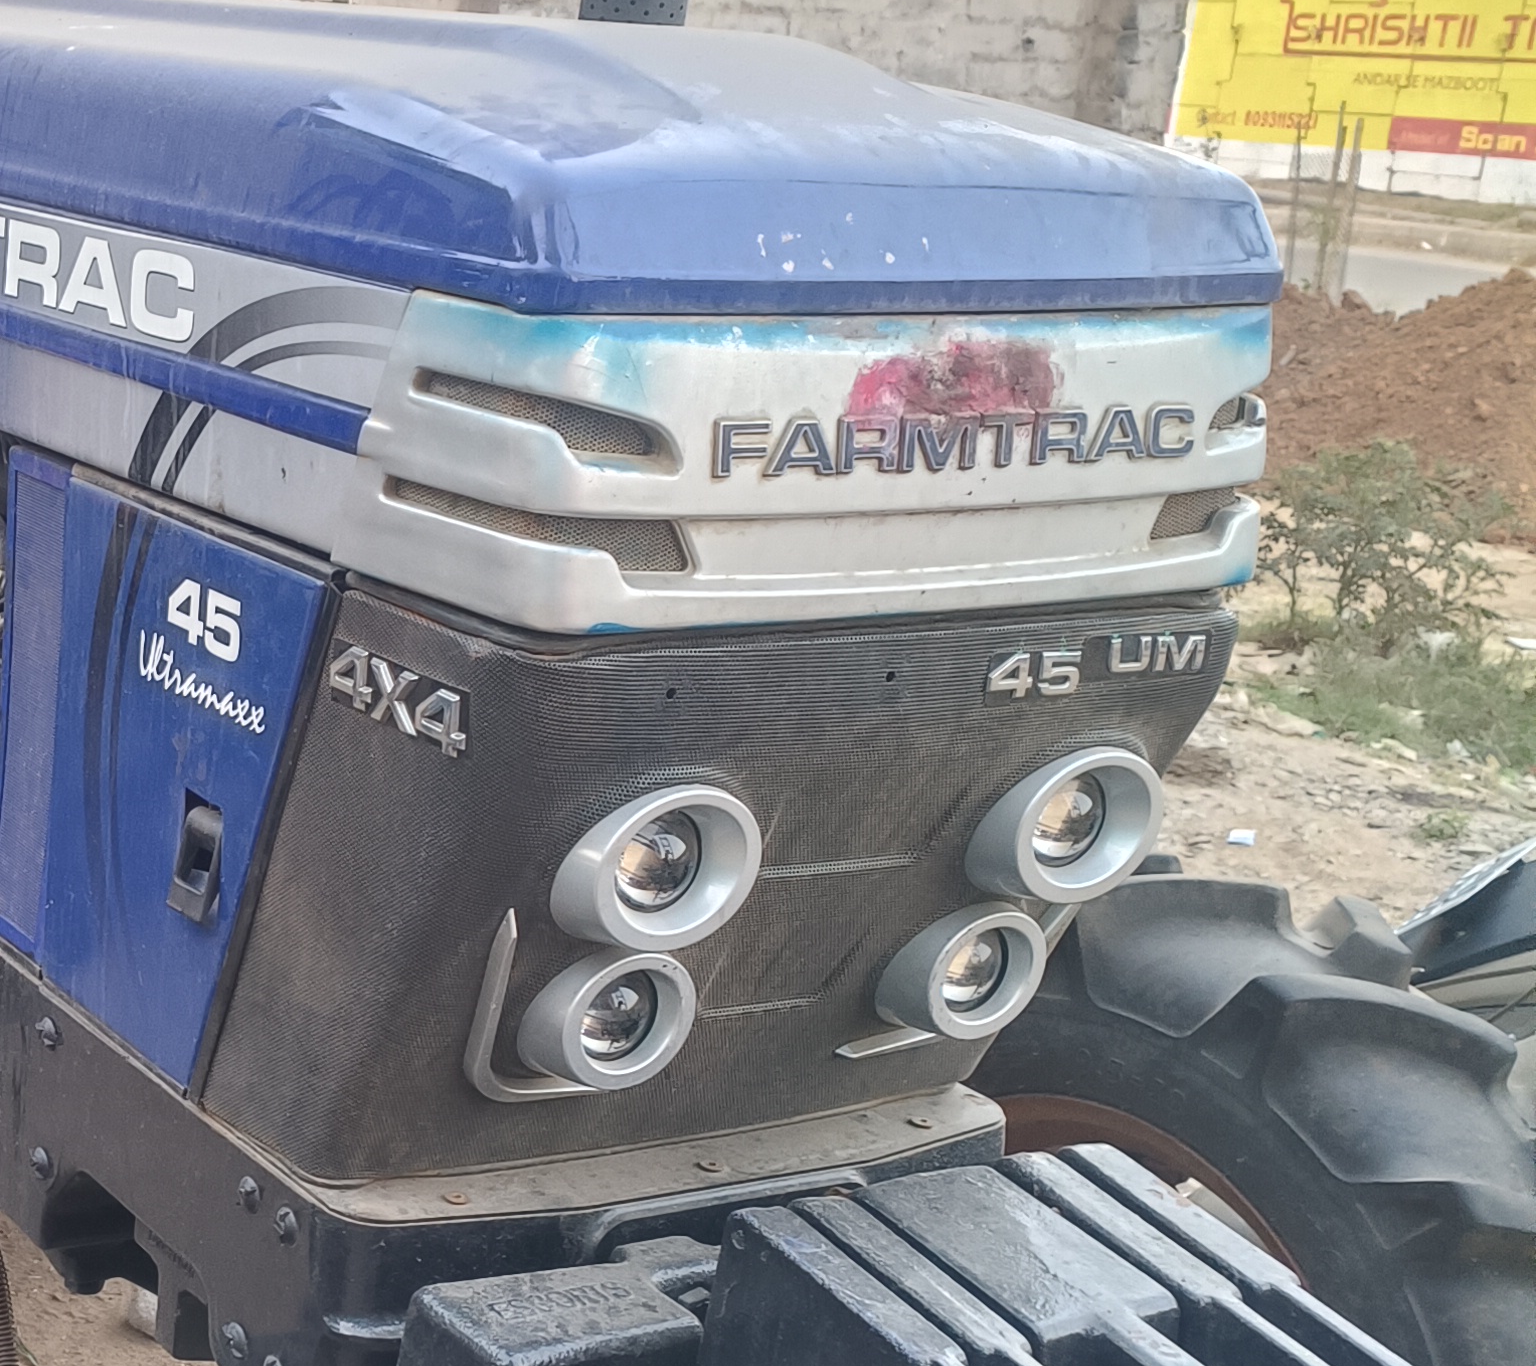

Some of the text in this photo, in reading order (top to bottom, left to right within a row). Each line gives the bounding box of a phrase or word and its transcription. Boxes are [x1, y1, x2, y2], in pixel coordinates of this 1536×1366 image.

[1459, 124, 1527, 153] Scan
[711, 403, 1196, 479] FARMTRAC
[166, 577, 243, 663] 45
[138, 628, 266, 735] Ultramaxx
[329, 645, 467, 759] 4X4
[985, 634, 1208, 700] 45 UM
